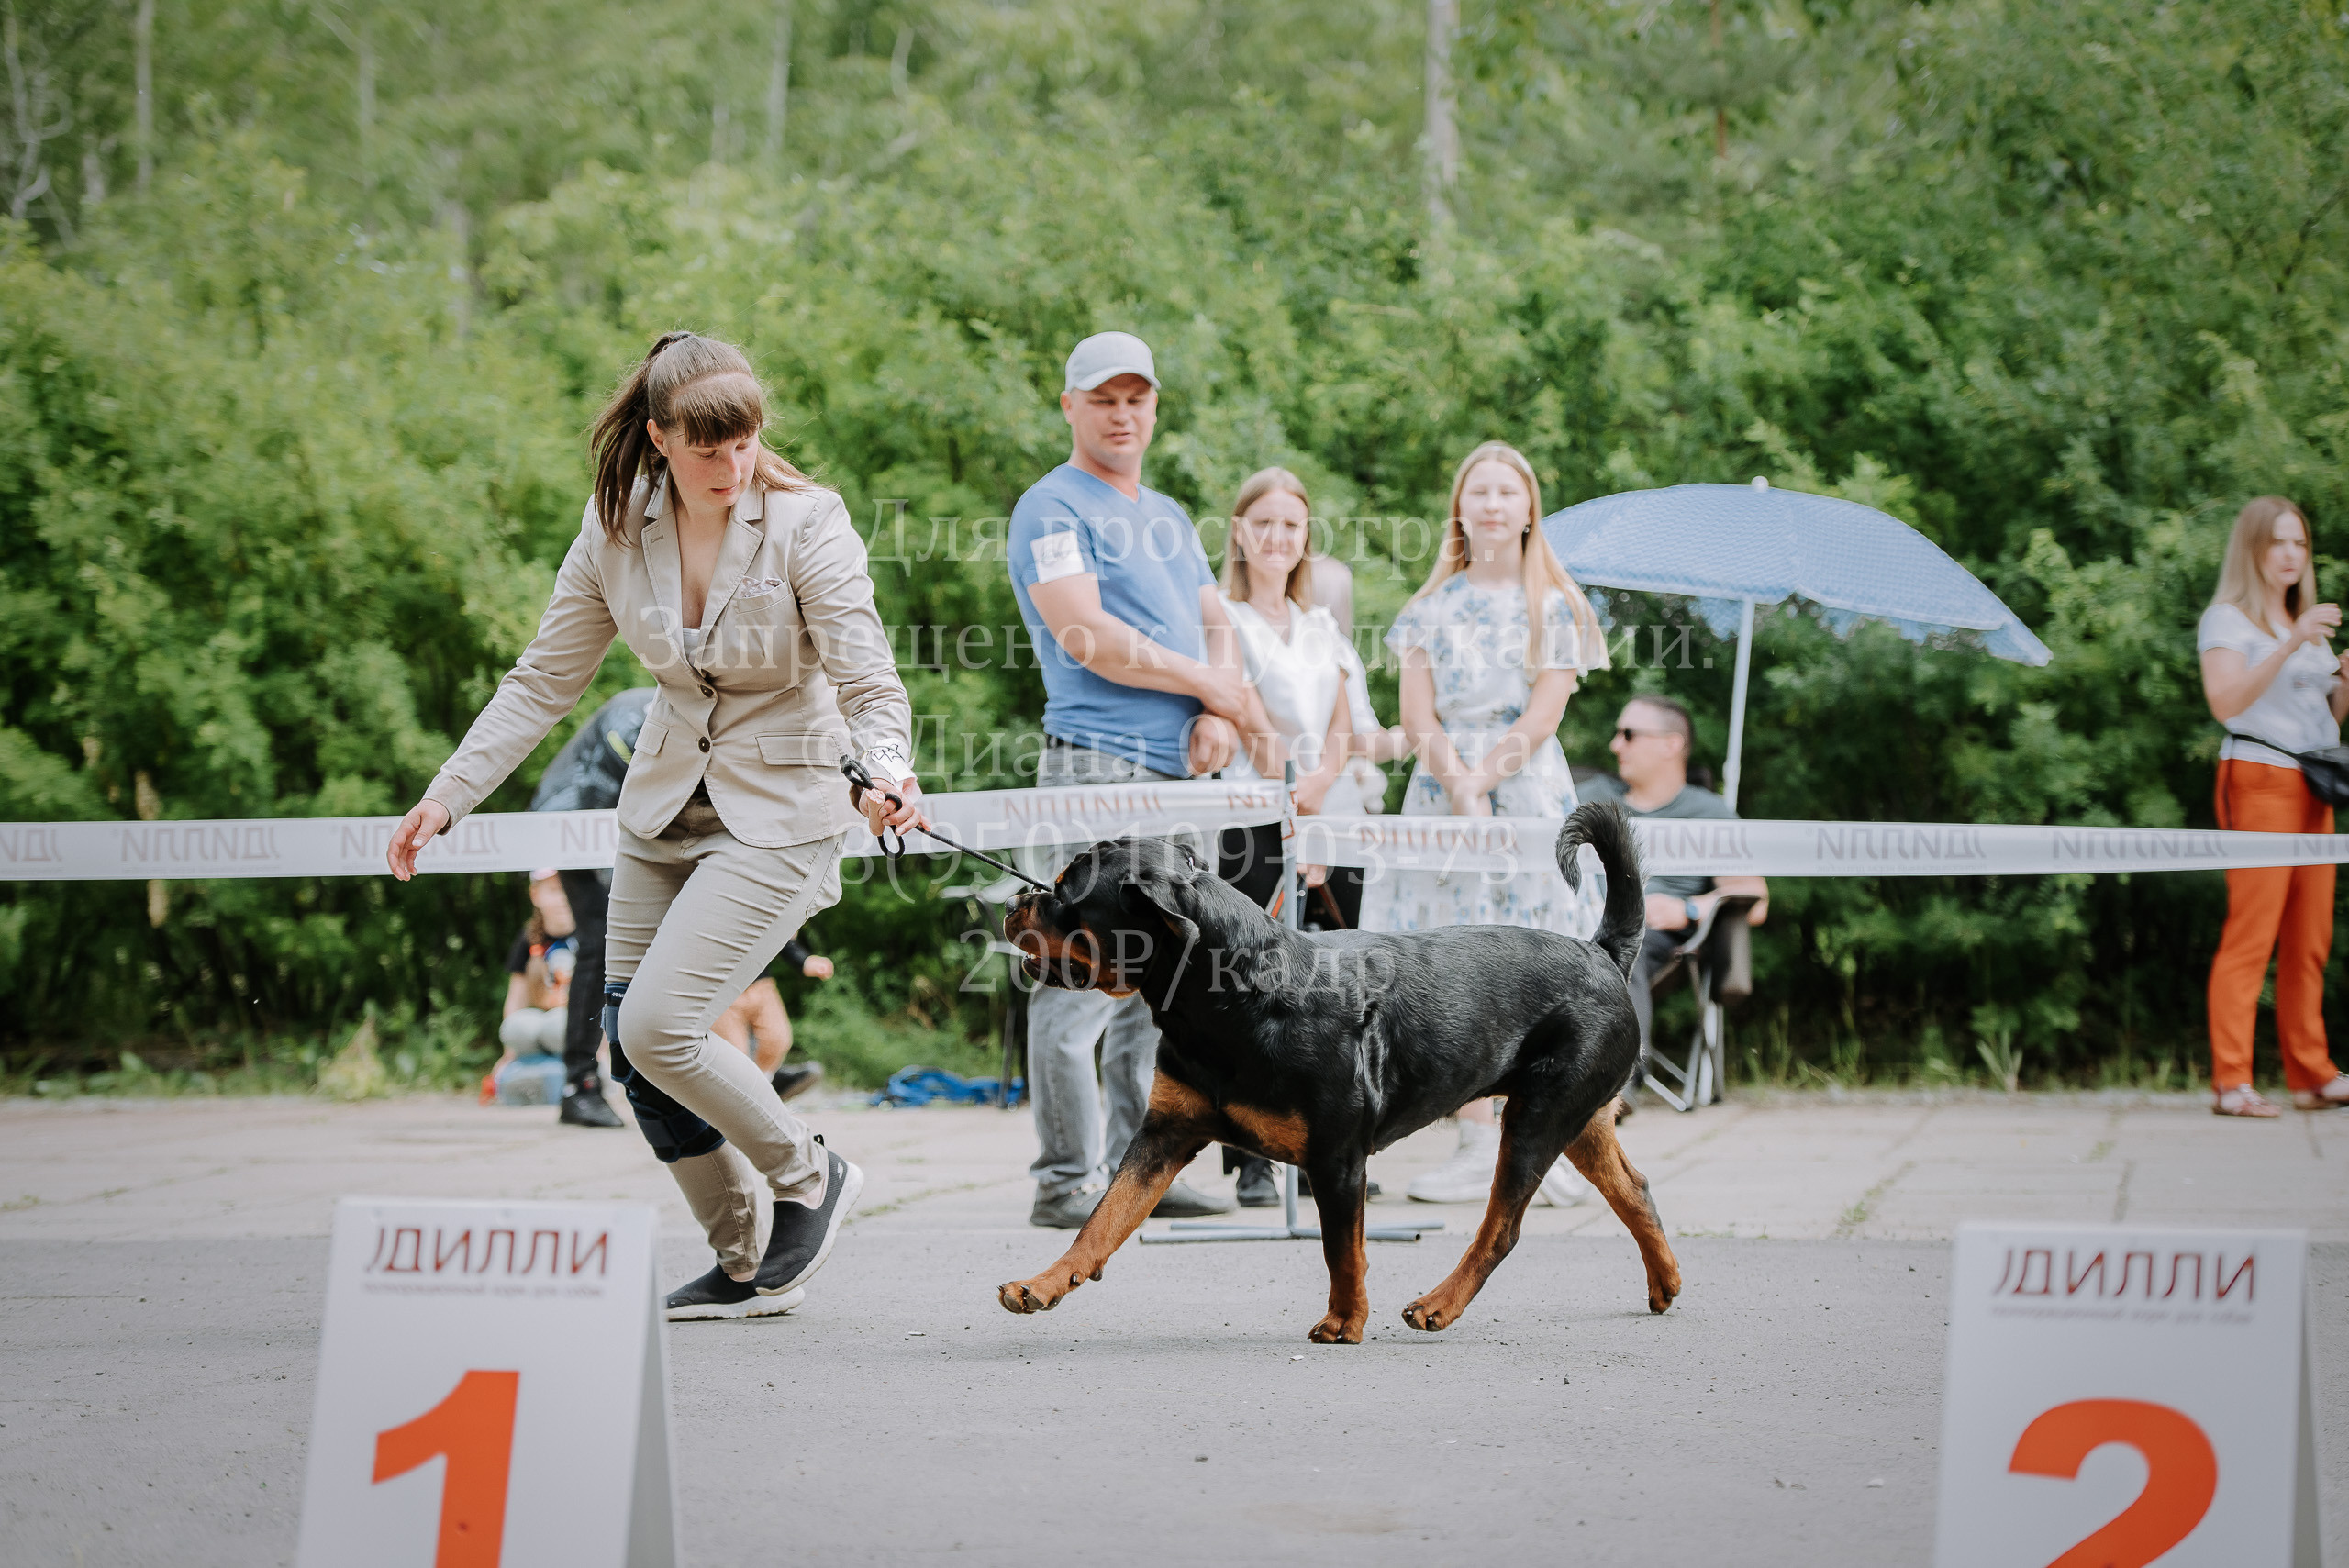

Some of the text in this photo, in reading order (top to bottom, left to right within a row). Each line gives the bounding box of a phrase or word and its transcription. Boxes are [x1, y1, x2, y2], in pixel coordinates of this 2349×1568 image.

[365, 1227, 609, 1275] ДИЛЛИ
[1993, 1249, 2256, 1302] ДИЛЛИ
[371, 1369, 521, 1568] 1
[2008, 1397, 2219, 1568] 2
